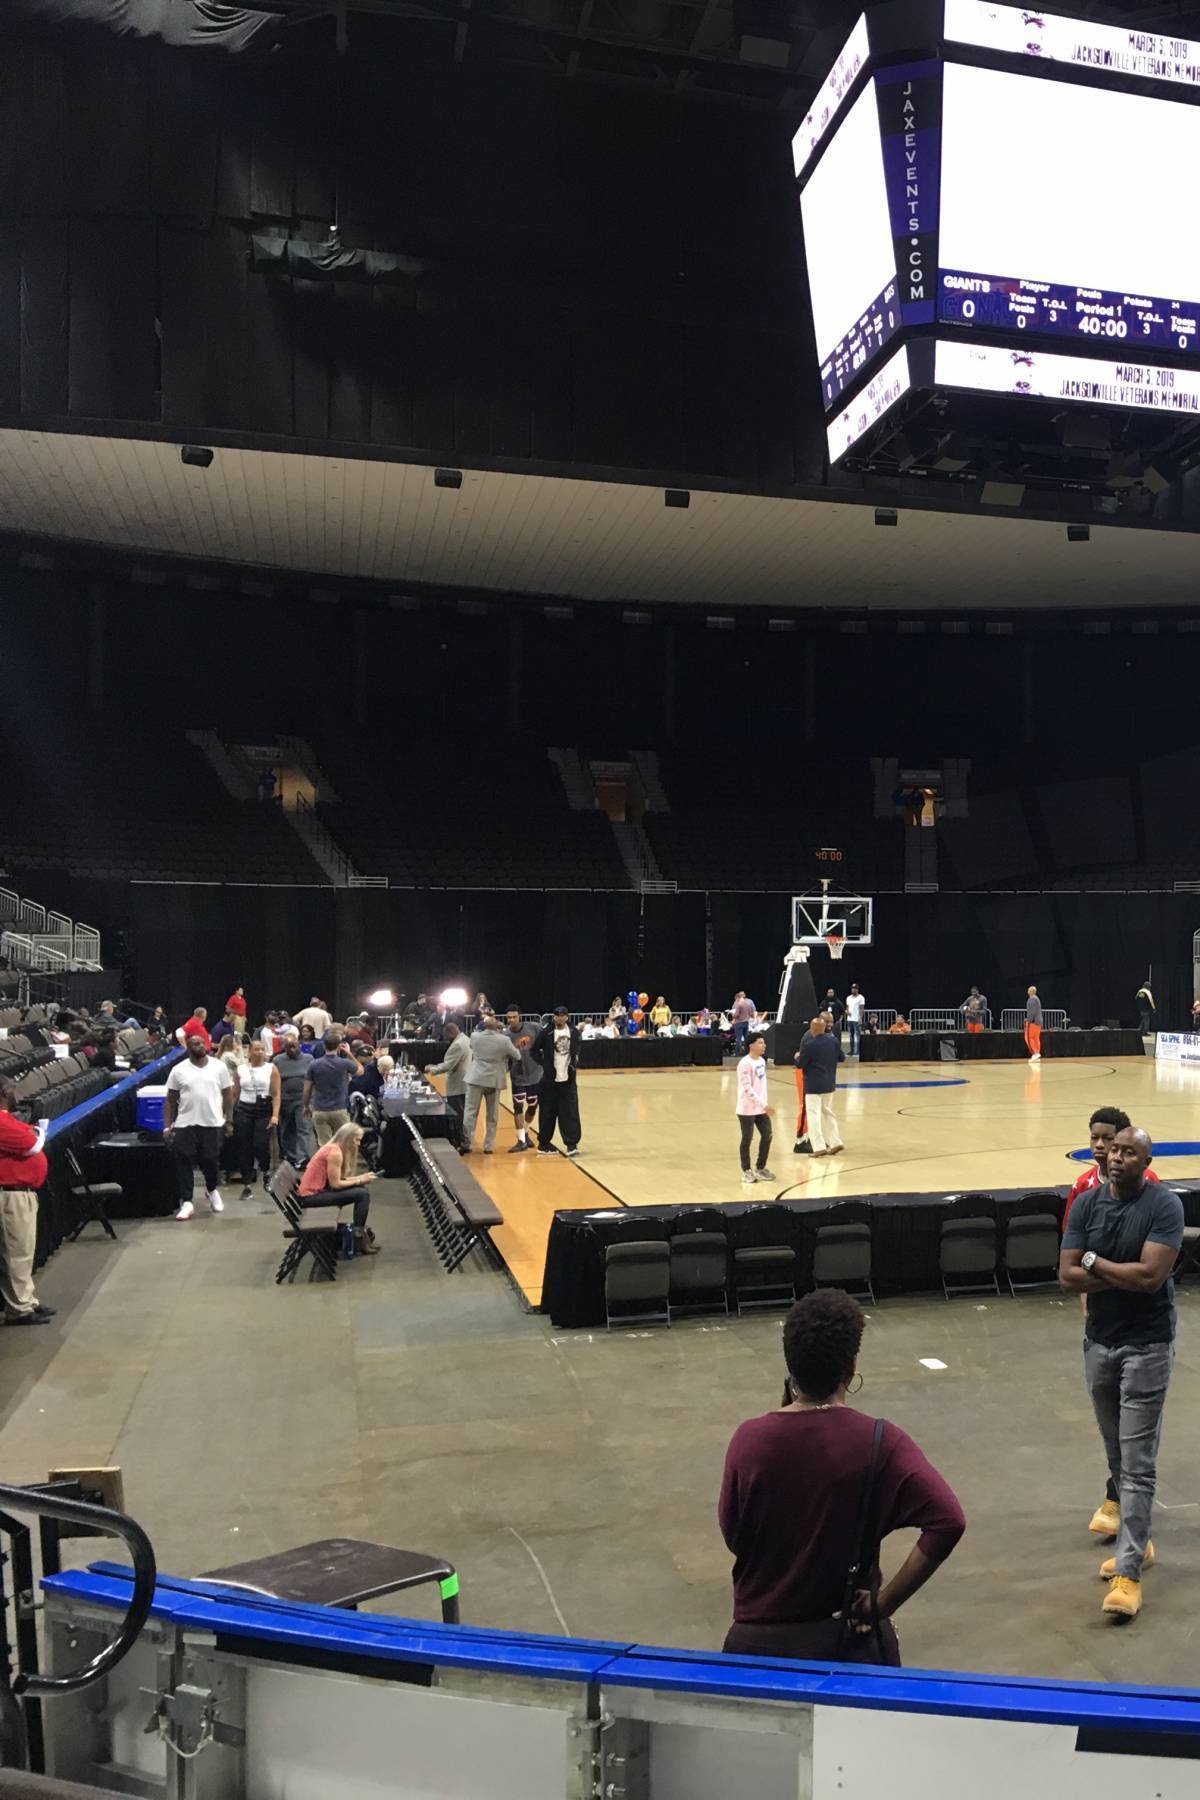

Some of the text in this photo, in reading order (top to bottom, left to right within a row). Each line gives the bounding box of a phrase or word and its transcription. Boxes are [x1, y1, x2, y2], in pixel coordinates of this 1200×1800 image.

[1128, 33, 1156, 53] MARCH
[1169, 41, 1188, 59] 2019
[1071, 45, 1130, 71] JACKSONVILLE
[1132, 55, 1172, 78] VETERANS
[943, 275, 990, 293] GIANTS
[962, 299, 975, 318] 0
[1049, 310, 1057, 322] 3
[1075, 302, 1115, 317] Period
[1017, 315, 1026, 328] 0
[1078, 316, 1128, 338] 40:00
[1143, 322, 1151, 335] 3
[1178, 335, 1188, 349] 0
[1116, 365, 1144, 383] MARCH
[1156, 371, 1174, 388] 2019
[1060, 379, 1118, 402] JACKSONVILLE
[1120, 385, 1159, 407] VETERANS
[1161, 391, 1199, 410] MEMORIAL
